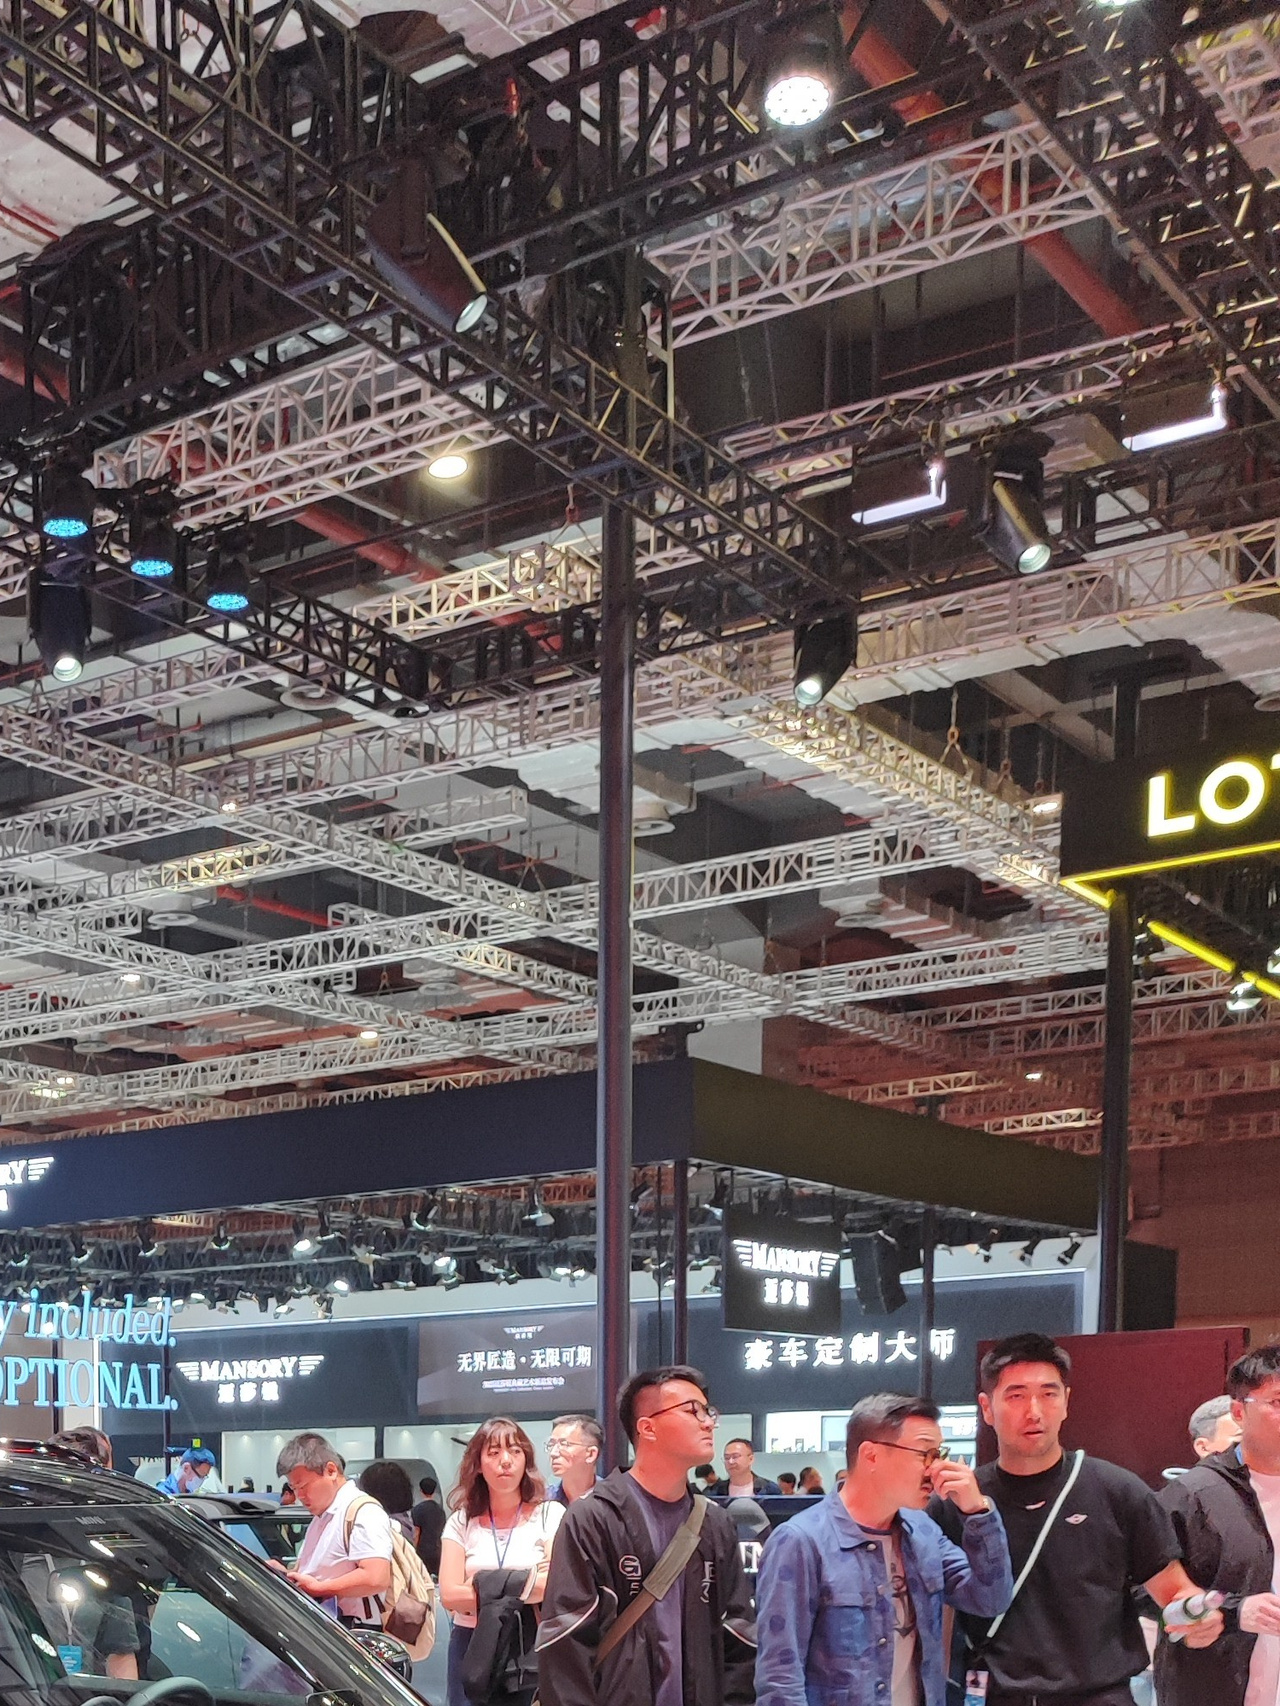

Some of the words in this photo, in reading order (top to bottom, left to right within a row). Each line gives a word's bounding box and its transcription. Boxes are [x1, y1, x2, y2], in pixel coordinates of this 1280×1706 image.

[1147, 754, 1280, 837] LO
[23, 1288, 177, 1348] included.
[200, 1356, 298, 1382] MANSORY
[744, 1328, 956, 1371] 豪车定制大师
